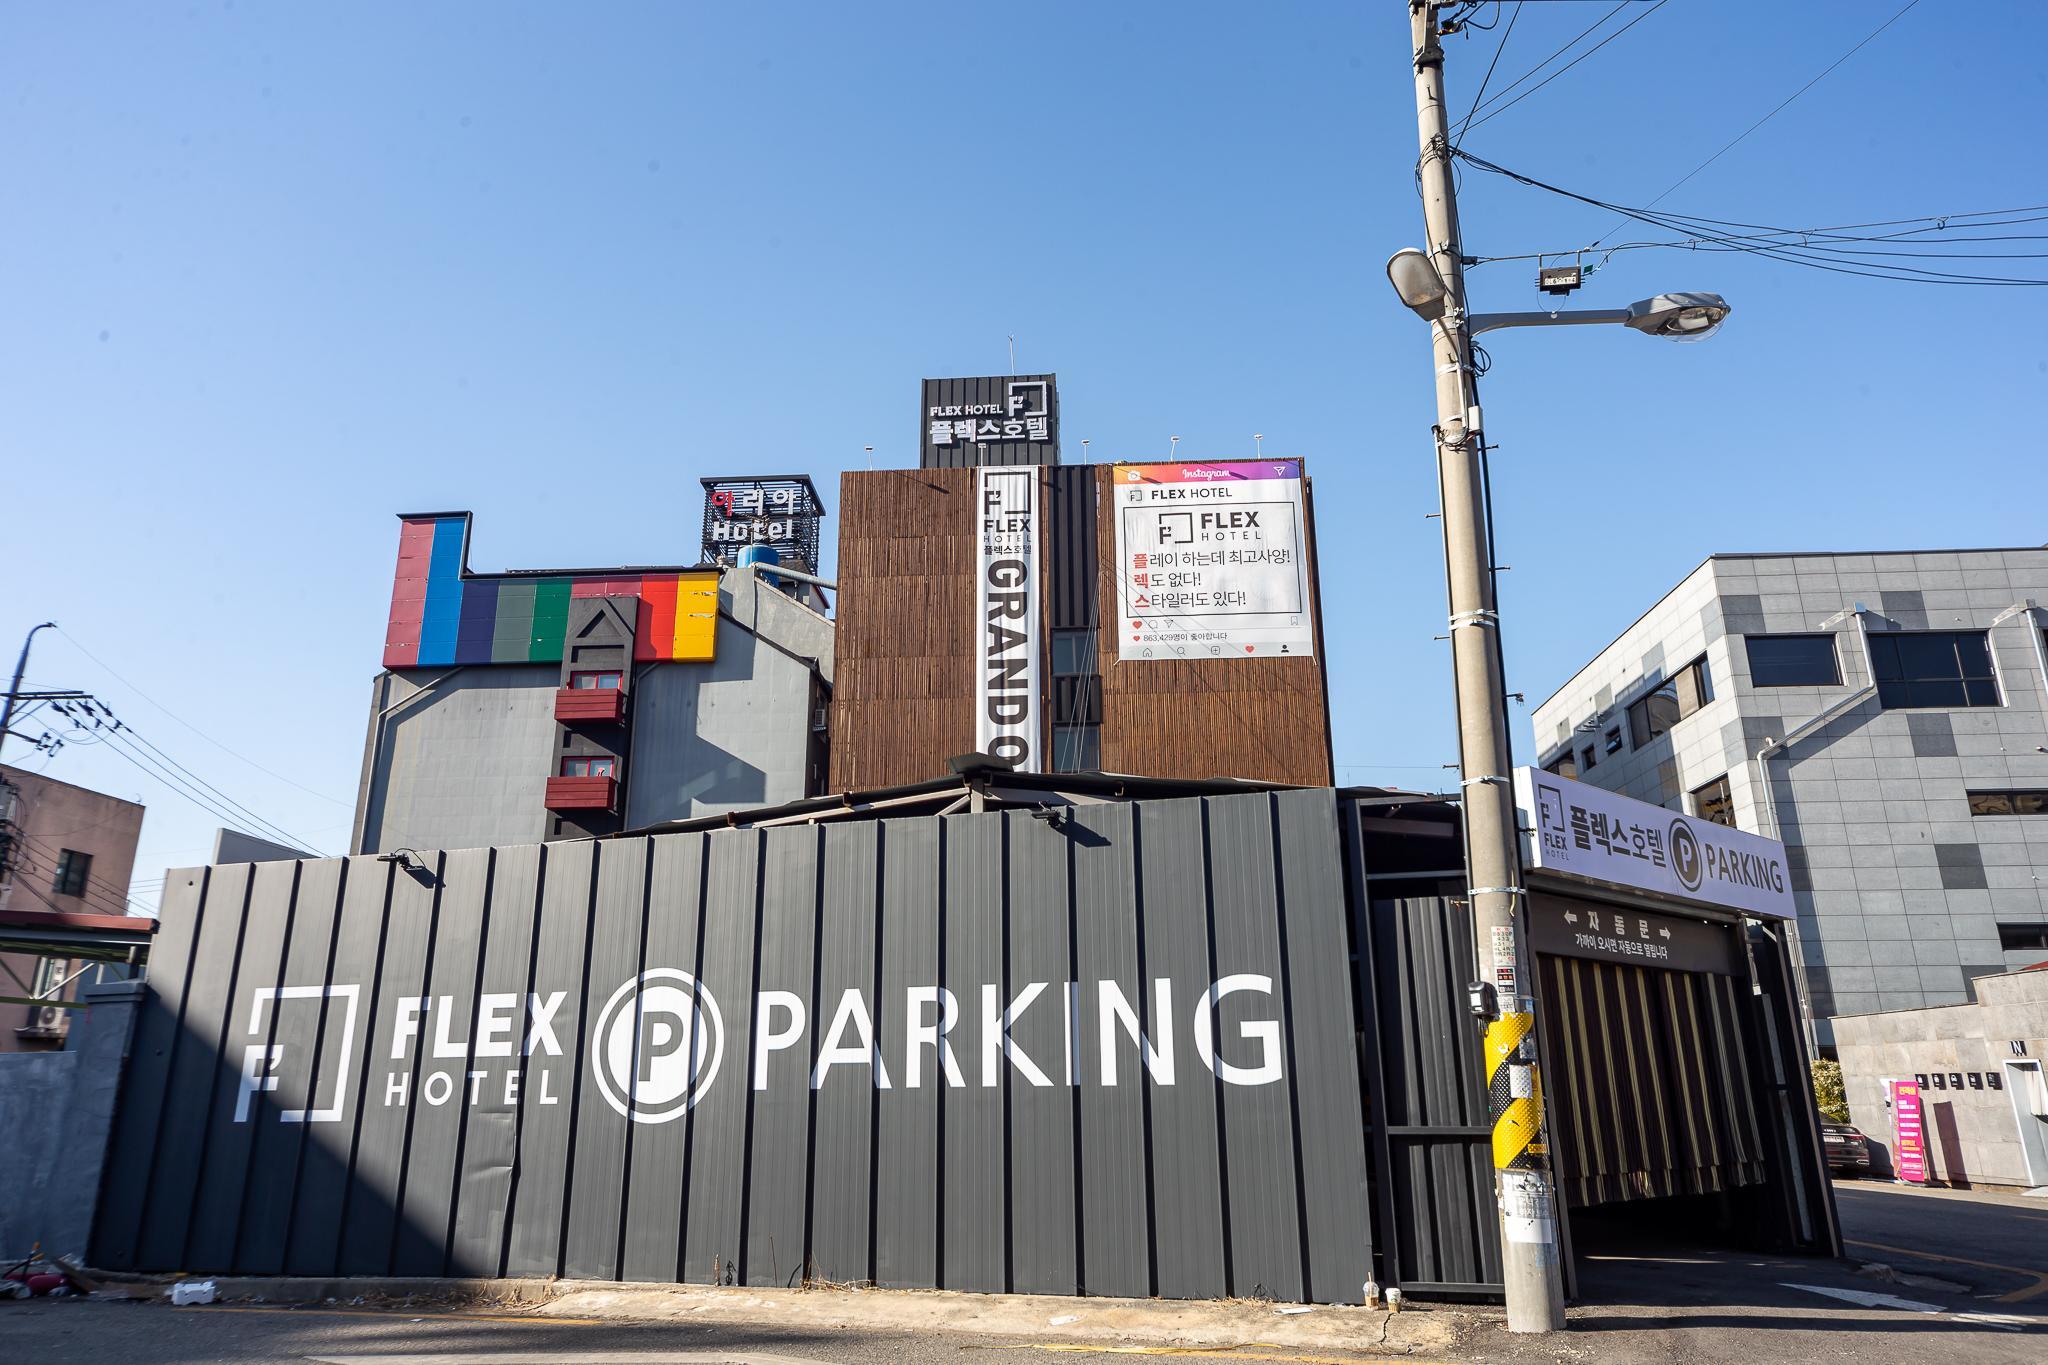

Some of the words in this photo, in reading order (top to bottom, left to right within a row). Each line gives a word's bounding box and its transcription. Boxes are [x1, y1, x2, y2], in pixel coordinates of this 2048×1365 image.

[930, 405, 962, 417] FLEX
[965, 404, 1003, 416] HOTEL
[929, 417, 1049, 445] 플렉스호텔
[1182, 468, 1231, 481] Instagram
[711, 488, 797, 517] 아리아
[1151, 489, 1186, 500] FLEX
[1190, 487, 1233, 498] HOTEL
[984, 518, 1031, 533] FLEX
[1201, 511, 1260, 529] FLEX
[712, 519, 793, 541] Hotel
[984, 534, 1031, 543] HOTEL
[1201, 531, 1262, 541] HOTEL
[984, 544, 1031, 556] 플렉스호텔
[1133, 551, 1178, 569] 플레이
[1181, 551, 1225, 566] 하는데
[1229, 548, 1291, 565] 최고사양!
[1133, 572, 1166, 589] 렉도
[1168, 571, 1201, 588] 없다!
[1135, 592, 1210, 609] 스타일러도
[1213, 590, 1246, 607] 있다!
[1190, 631, 1228, 642] 좋아합니다
[1543, 832, 1568, 851] FLEX
[1570, 805, 1667, 868] 플렉스호텔
[1545, 849, 1569, 861] HOTEL
[1705, 843, 1784, 894] PARKING
[1575, 932, 1597, 950] 가까이
[1598, 936, 1618, 953] 오시면
[1618, 939, 1644, 956] 자동으로
[1644, 943, 1668, 960] 열립니다
[390, 991, 569, 1059] FLEX
[753, 973, 1284, 1091] PARKING
[384, 1069, 559, 1107] HOTEL
